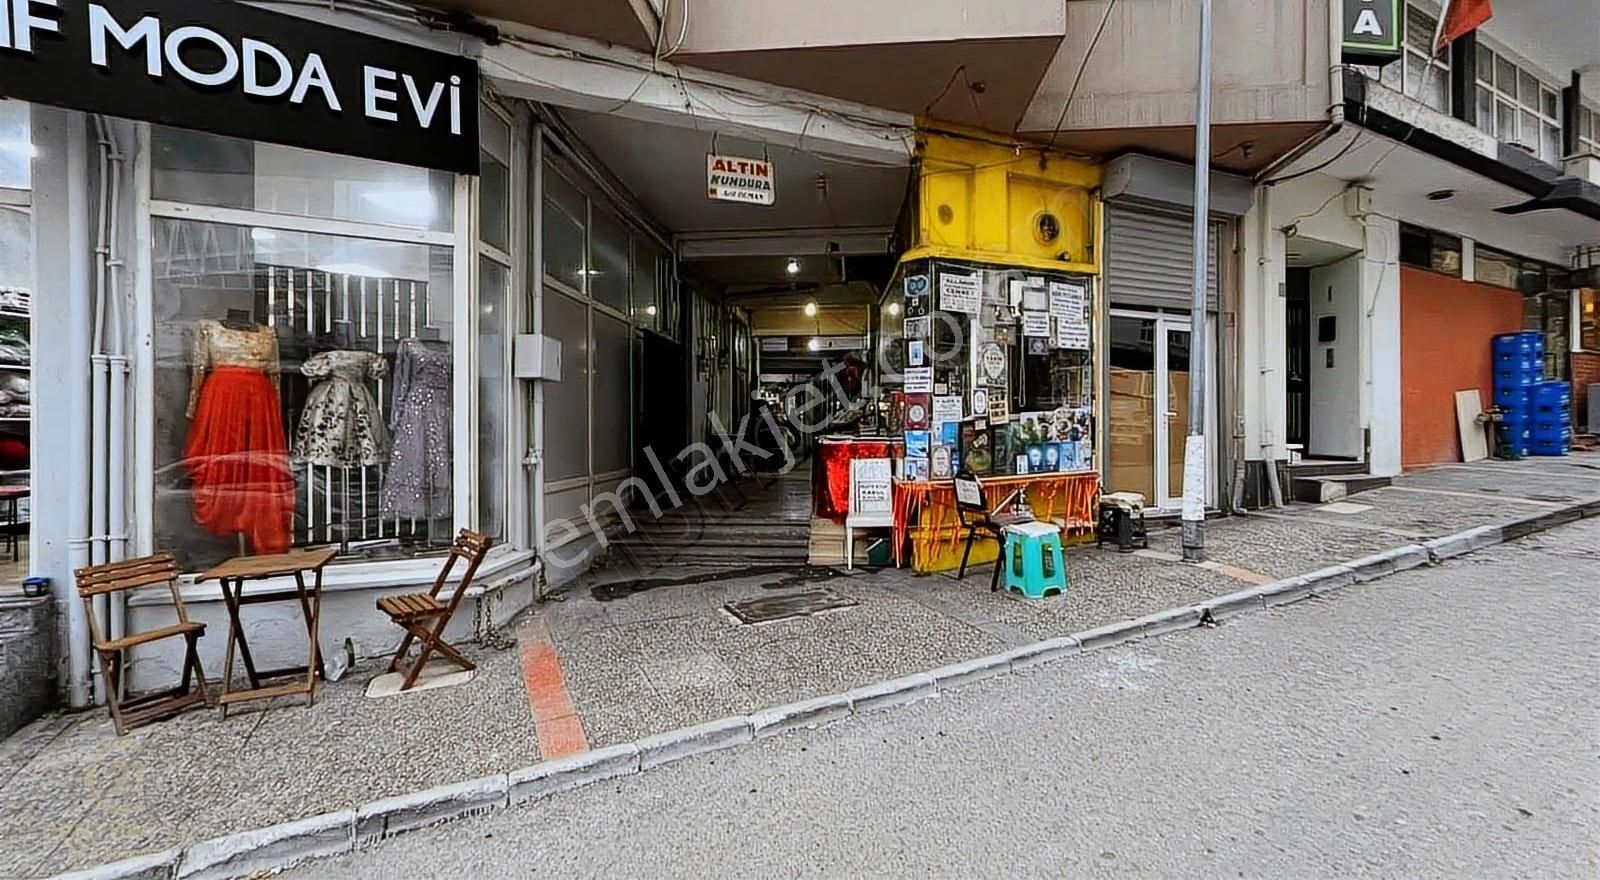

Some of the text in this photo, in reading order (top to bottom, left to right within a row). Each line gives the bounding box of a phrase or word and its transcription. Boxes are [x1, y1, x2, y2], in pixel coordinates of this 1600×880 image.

[89, 4, 341, 111] MODA
[364, 65, 461, 135] EVİ
[712, 159, 769, 177] ALTIN
[710, 174, 771, 191] KUNDURA
